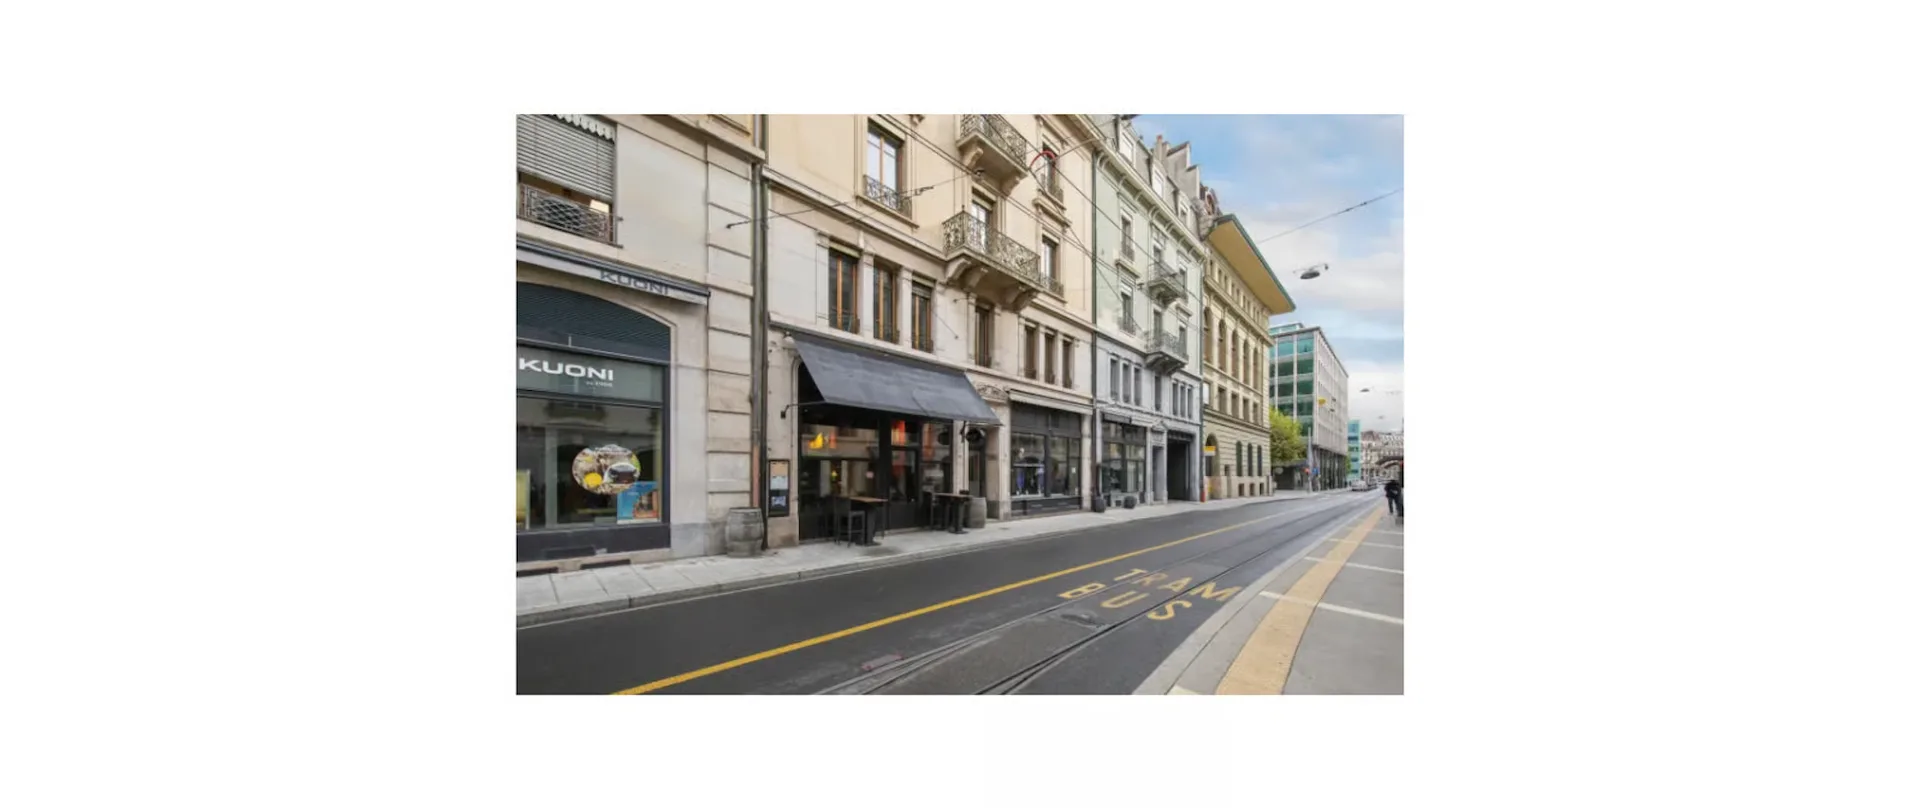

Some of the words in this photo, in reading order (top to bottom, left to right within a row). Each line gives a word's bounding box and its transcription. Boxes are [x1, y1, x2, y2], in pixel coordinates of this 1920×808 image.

[601, 270, 669, 295] KUONI
[519, 357, 614, 381] KUONI
[1113, 568, 1242, 601] TRAM
[1057, 582, 1192, 620] BUS
